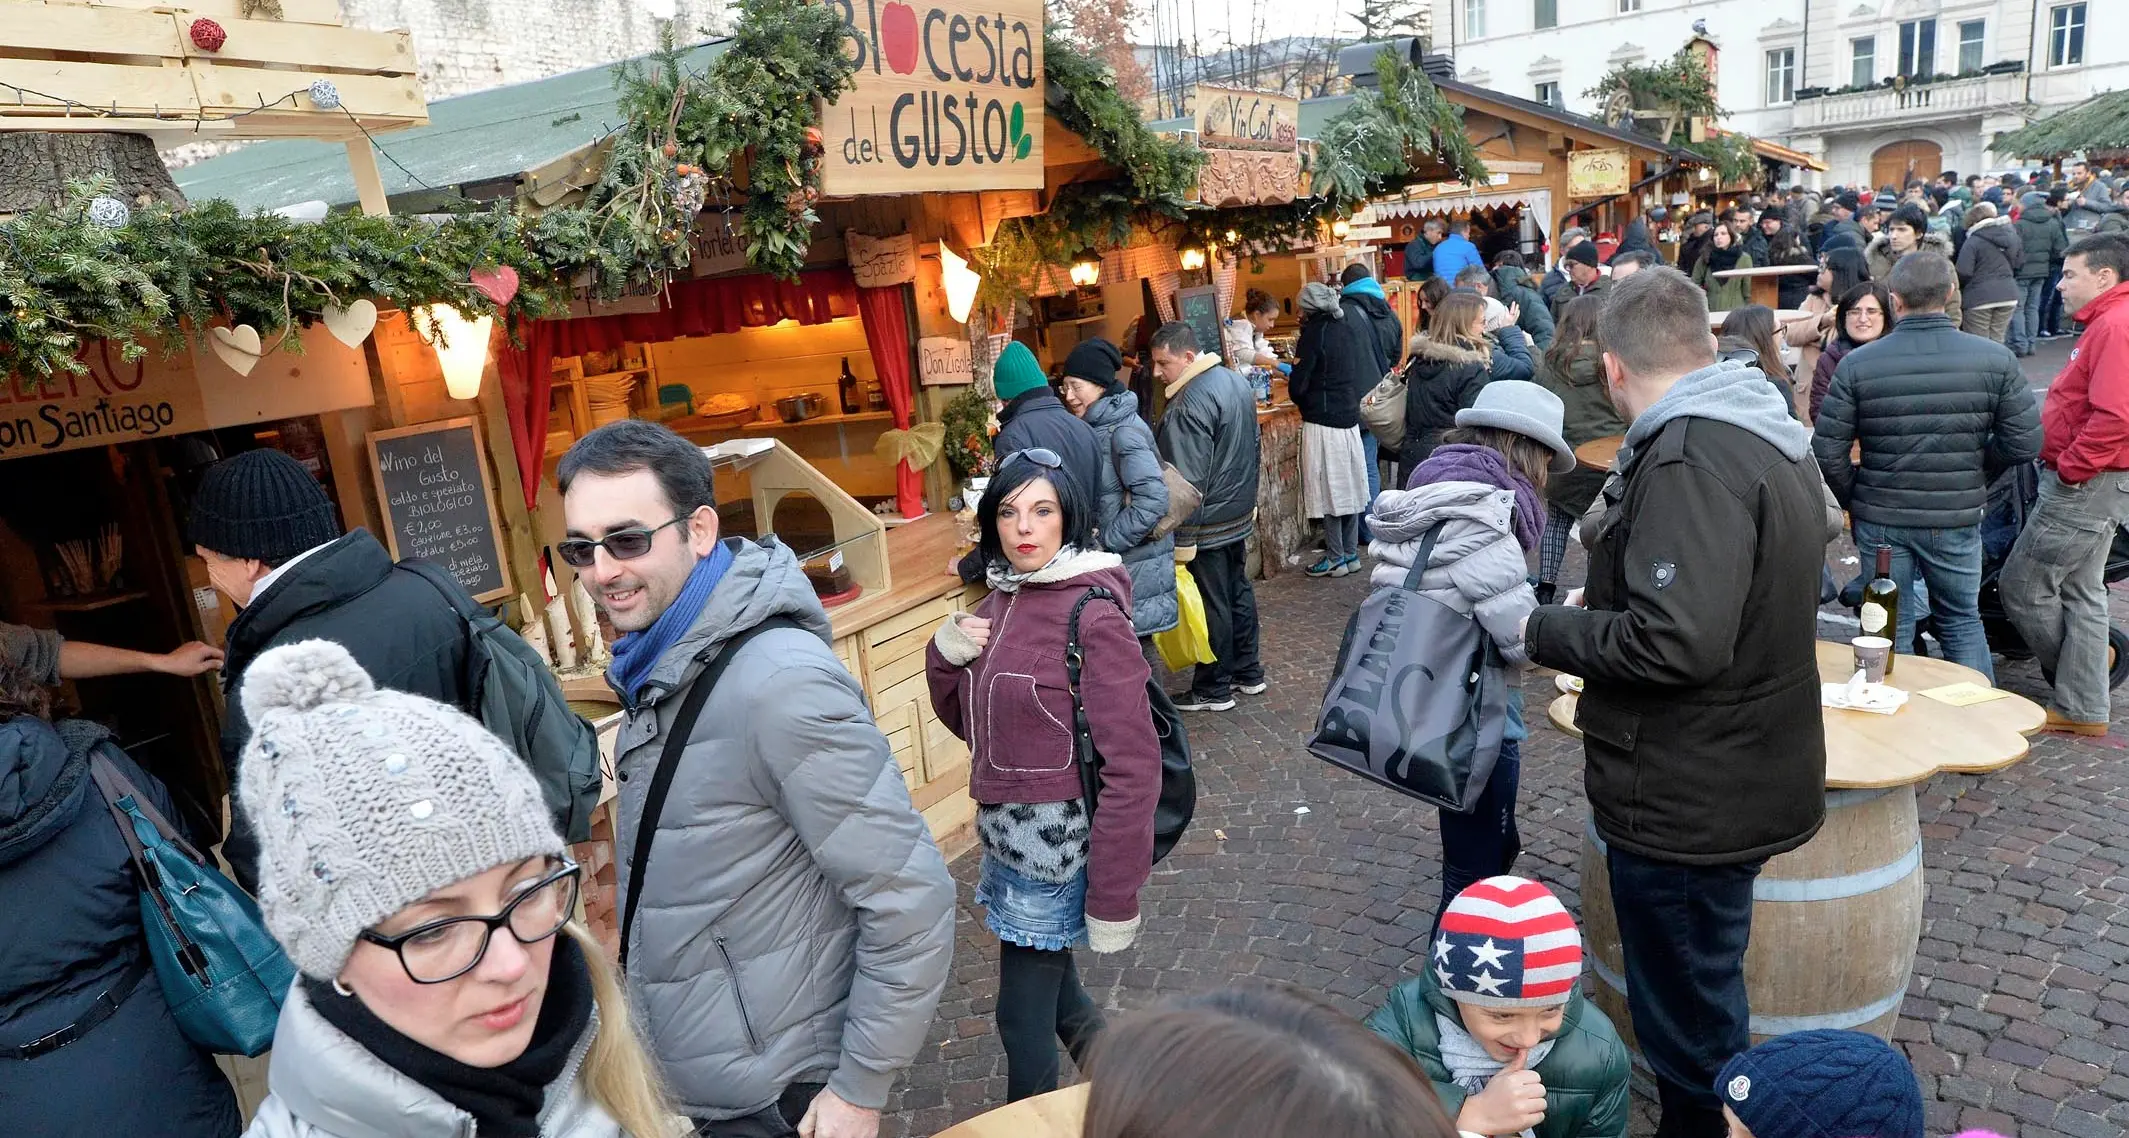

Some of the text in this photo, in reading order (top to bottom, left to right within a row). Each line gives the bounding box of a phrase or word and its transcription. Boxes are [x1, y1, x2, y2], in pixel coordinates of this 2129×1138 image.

[843, 105, 884, 166] del
[0, 398, 174, 455] on Santiago
[383, 444, 444, 471] Vino del
[418, 464, 459, 486] Gusto
[391, 490, 418, 506] caldo
[408, 494, 473, 518] BIOLOGICO
[1317, 619, 1401, 771] BLACK
